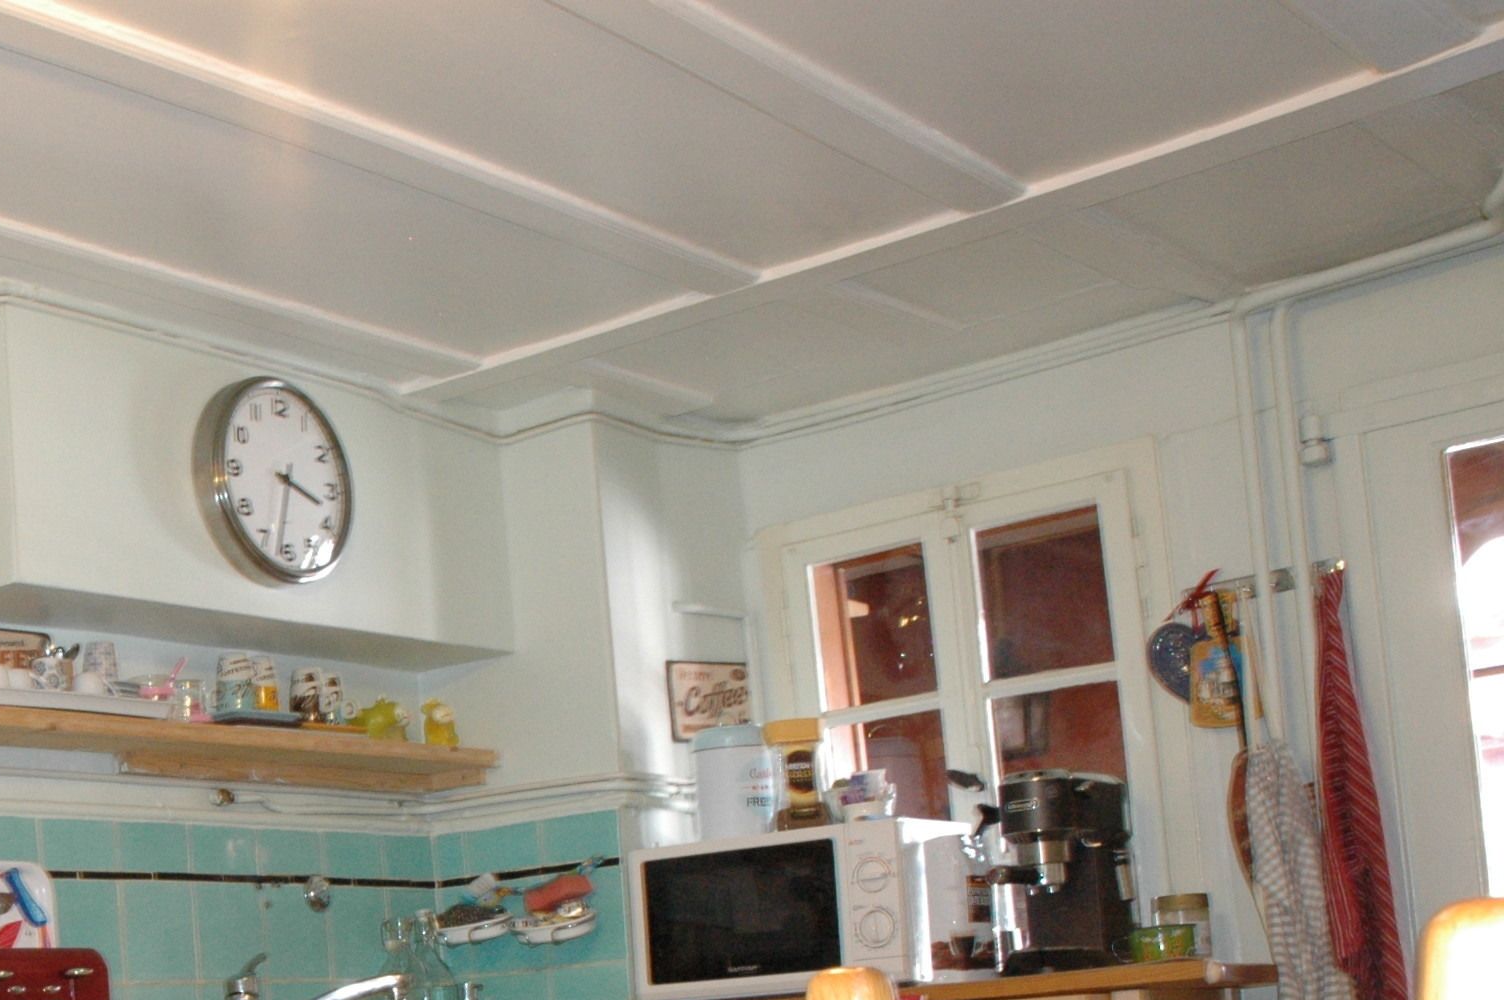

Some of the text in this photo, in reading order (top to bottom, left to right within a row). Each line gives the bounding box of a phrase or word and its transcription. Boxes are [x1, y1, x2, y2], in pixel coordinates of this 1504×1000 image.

[250, 403, 262, 421] 11
[271, 398, 290, 418] 12
[301, 414, 308, 432] 1
[233, 424, 249, 444] 10
[315, 444, 329, 463] 2
[226, 458, 243, 477] 9
[324, 483, 339, 501] 3
[237, 498, 254, 517] 8
[257, 528, 270, 548] 7
[280, 543, 297, 562] 6
